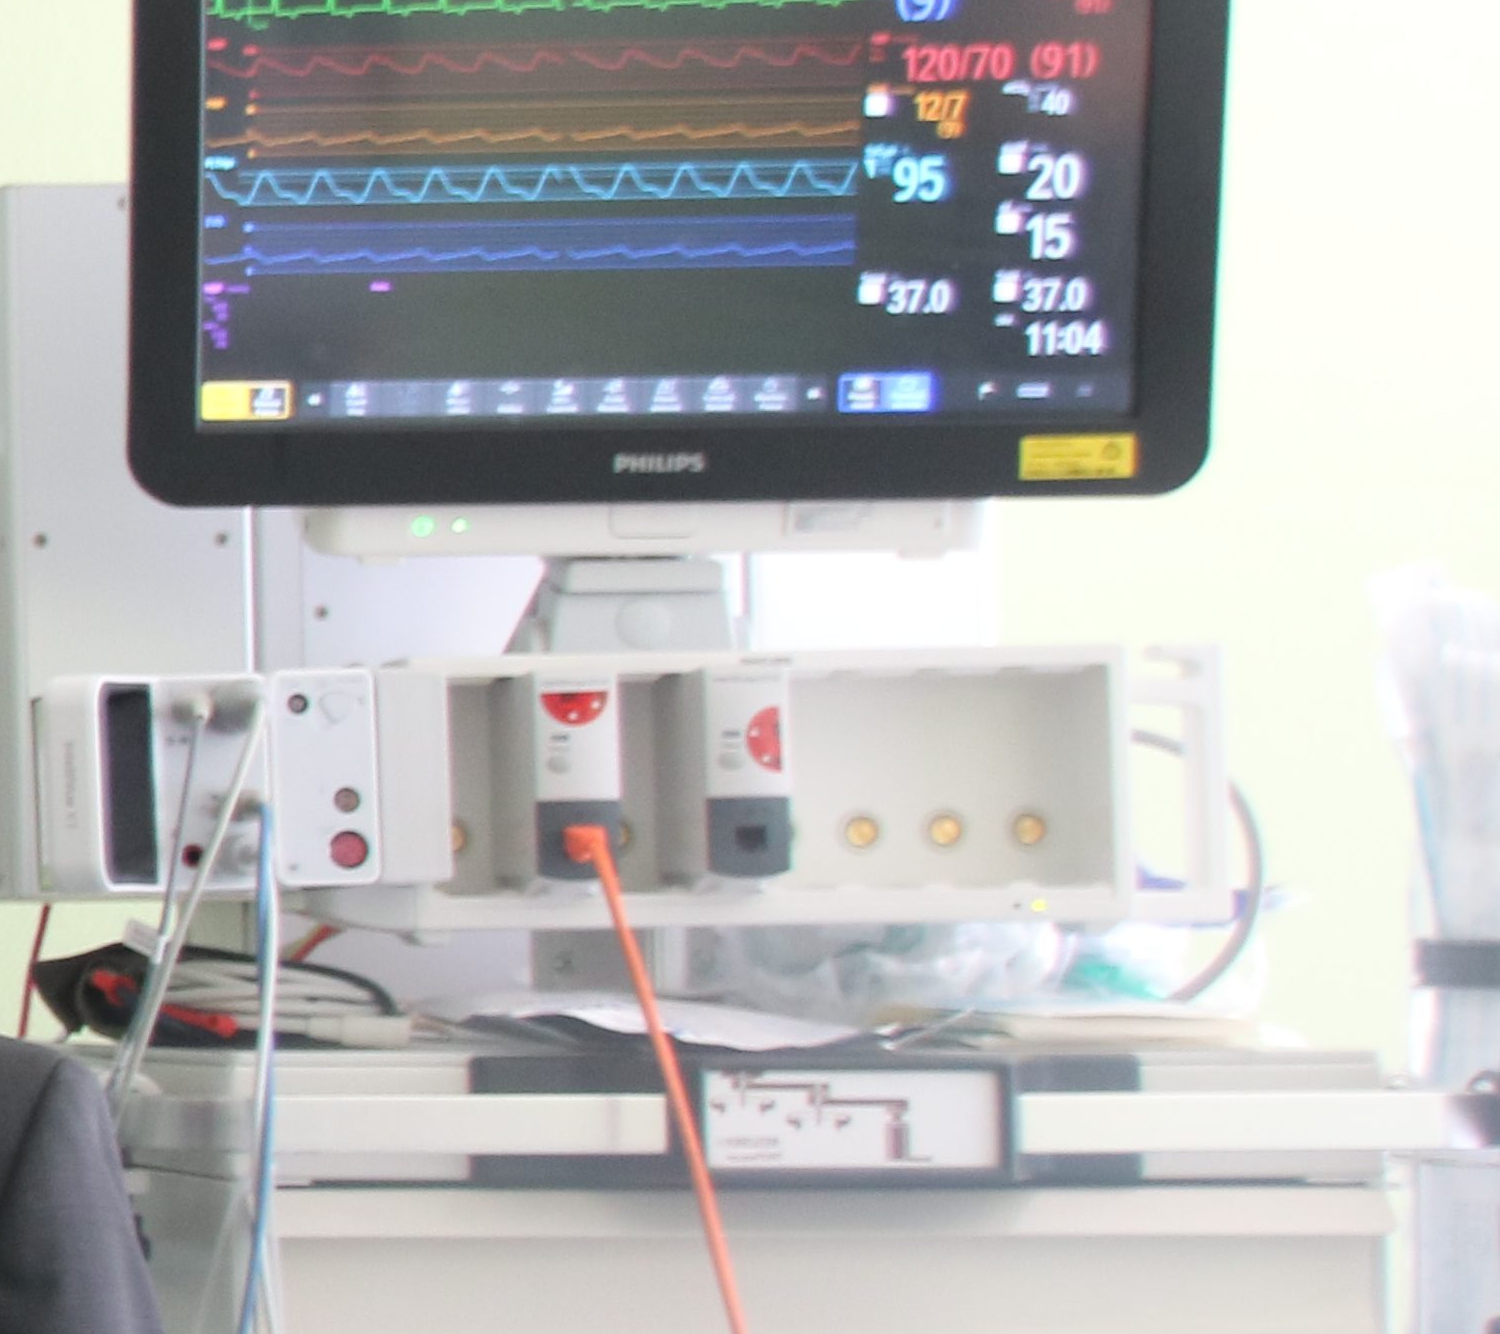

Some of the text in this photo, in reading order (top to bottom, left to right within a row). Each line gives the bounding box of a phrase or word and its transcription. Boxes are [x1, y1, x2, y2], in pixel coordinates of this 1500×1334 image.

[903, 41, 1100, 82] 120/70 (91)
[915, 90, 969, 121] 12/7
[893, 155, 947, 203] 95
[1027, 153, 1085, 200] 20
[1026, 214, 1074, 260] 15
[887, 279, 955, 314] 37.0
[1022, 277, 1091, 312] 37.0
[1025, 320, 1107, 356] 11:04
[613, 452, 704, 474] PHILIPS
